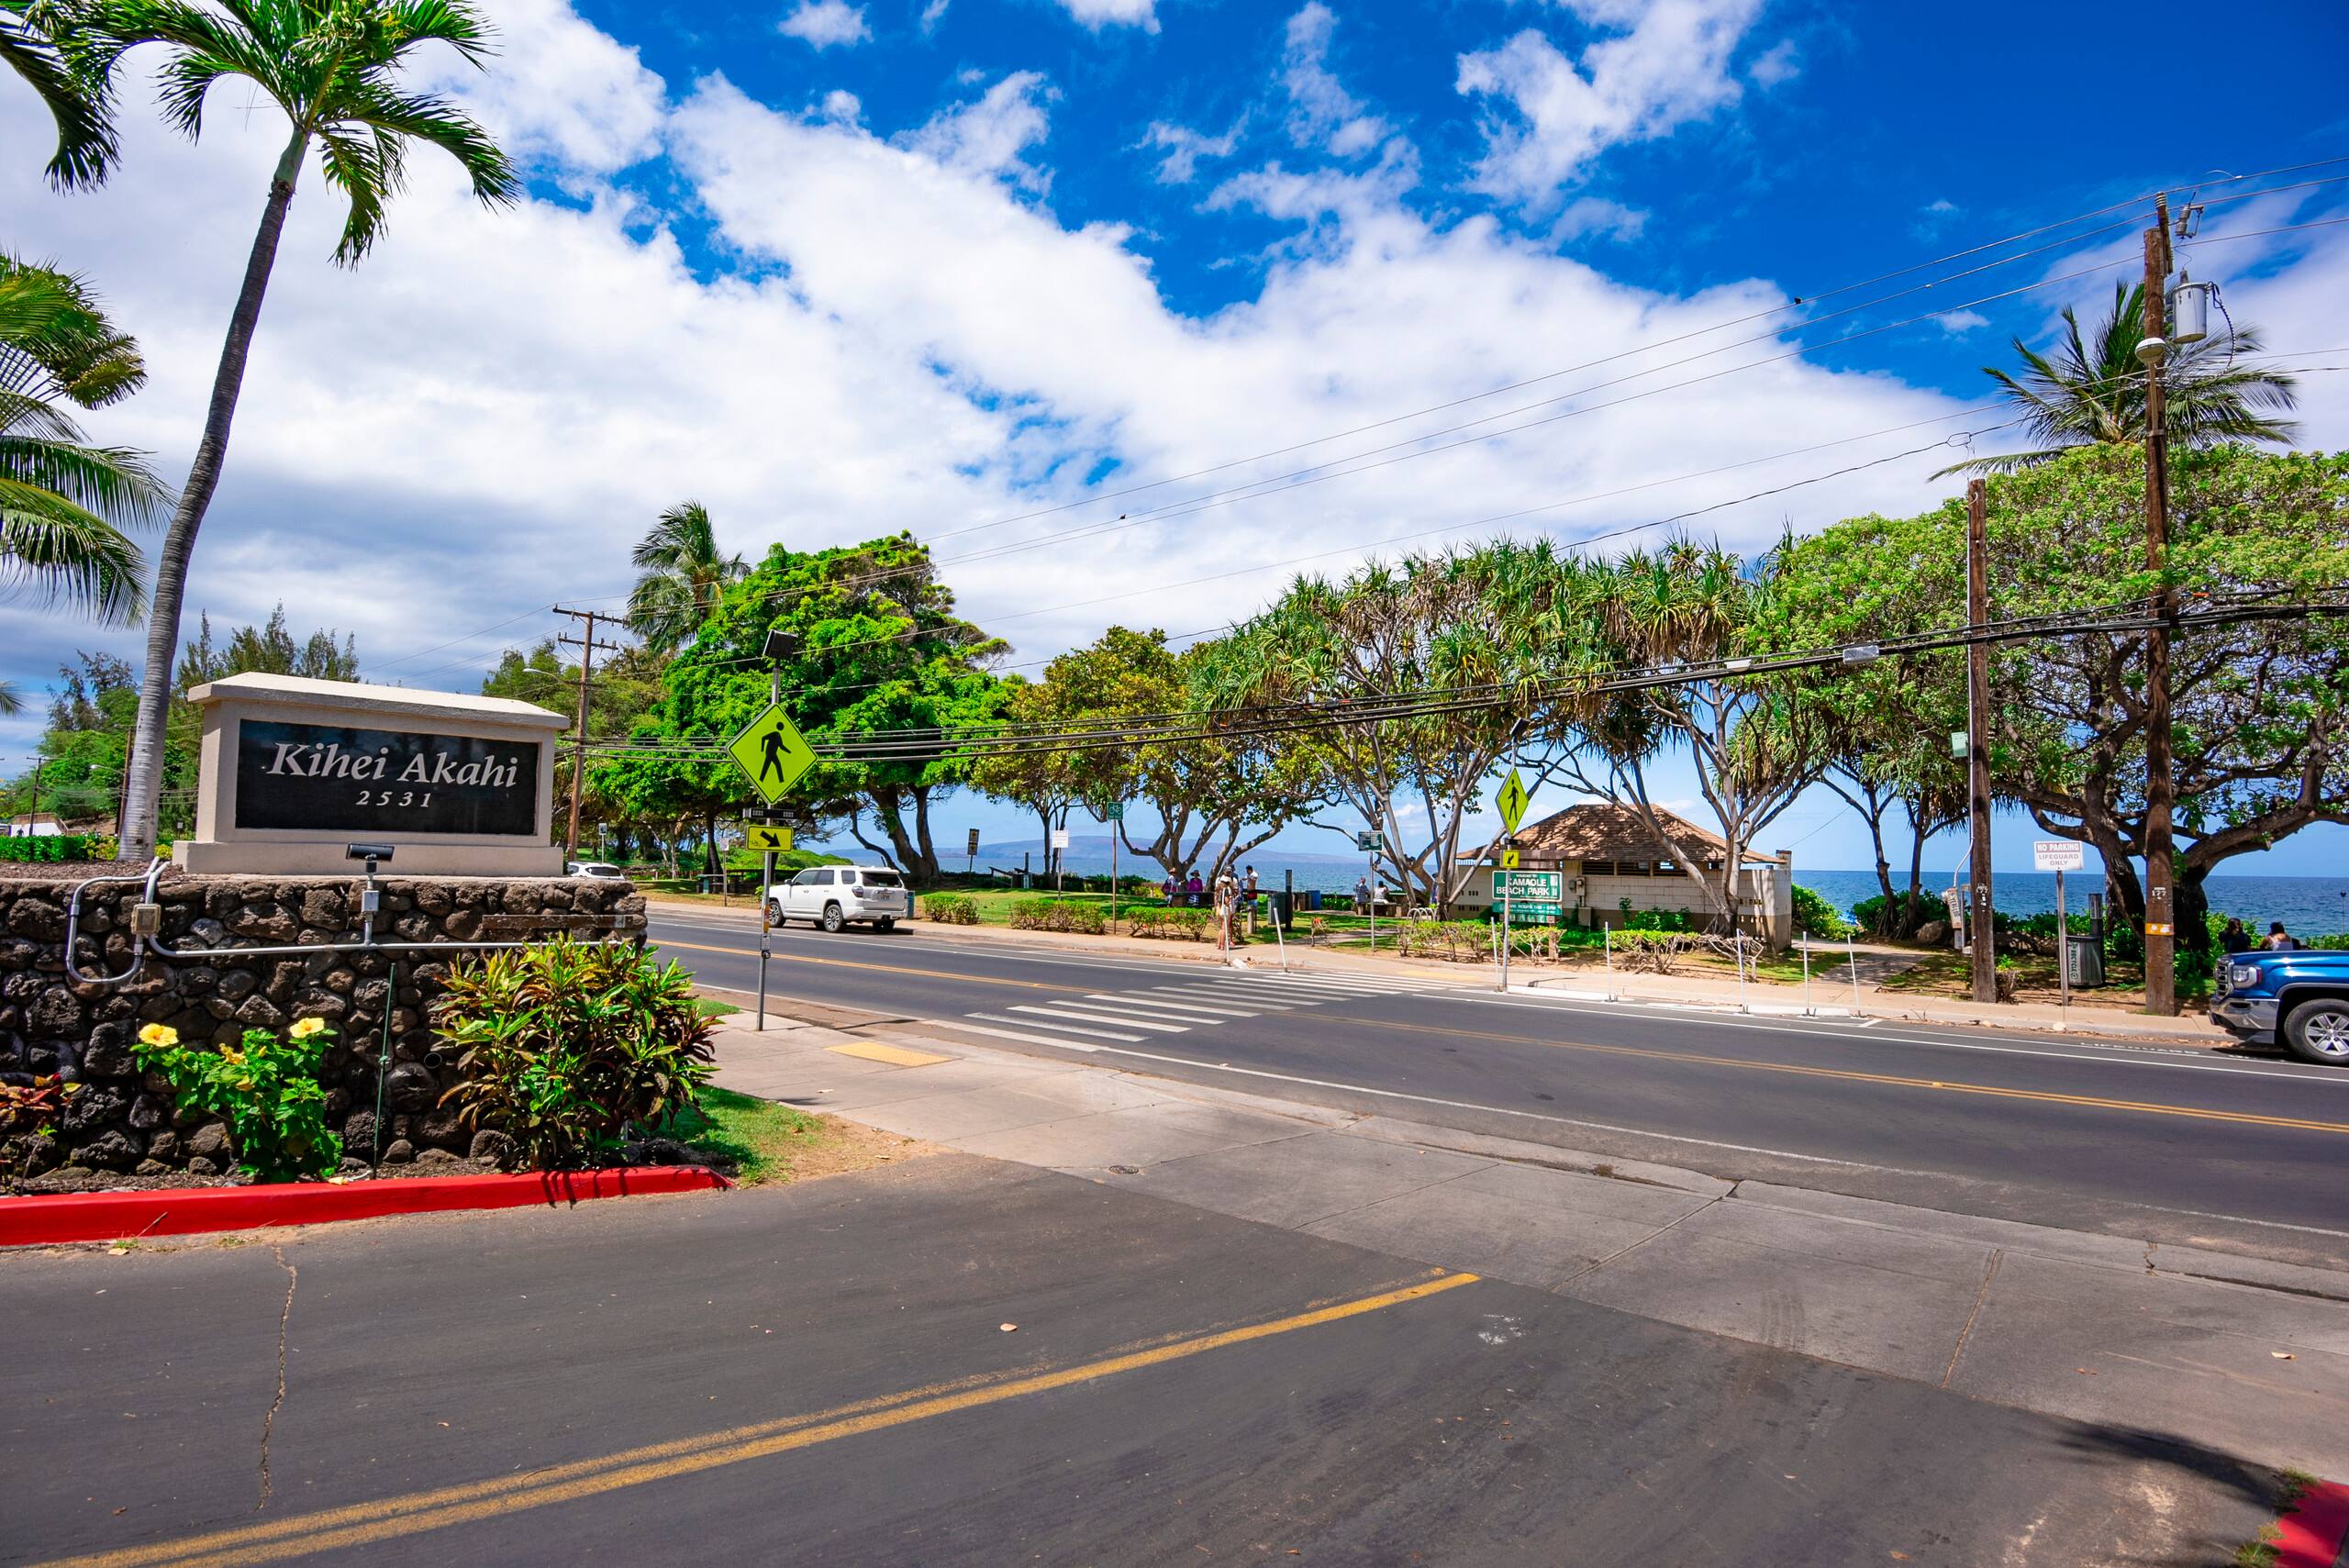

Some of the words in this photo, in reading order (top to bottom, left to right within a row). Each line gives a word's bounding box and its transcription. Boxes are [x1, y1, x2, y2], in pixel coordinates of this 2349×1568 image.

[266, 742, 389, 781] Kihei
[396, 751, 518, 788] Akahi
[356, 790, 432, 808] 2531
[2037, 843, 2047, 851] NO
[2049, 843, 2079, 851] PARKING
[1527, 887, 1550, 896] PARK
